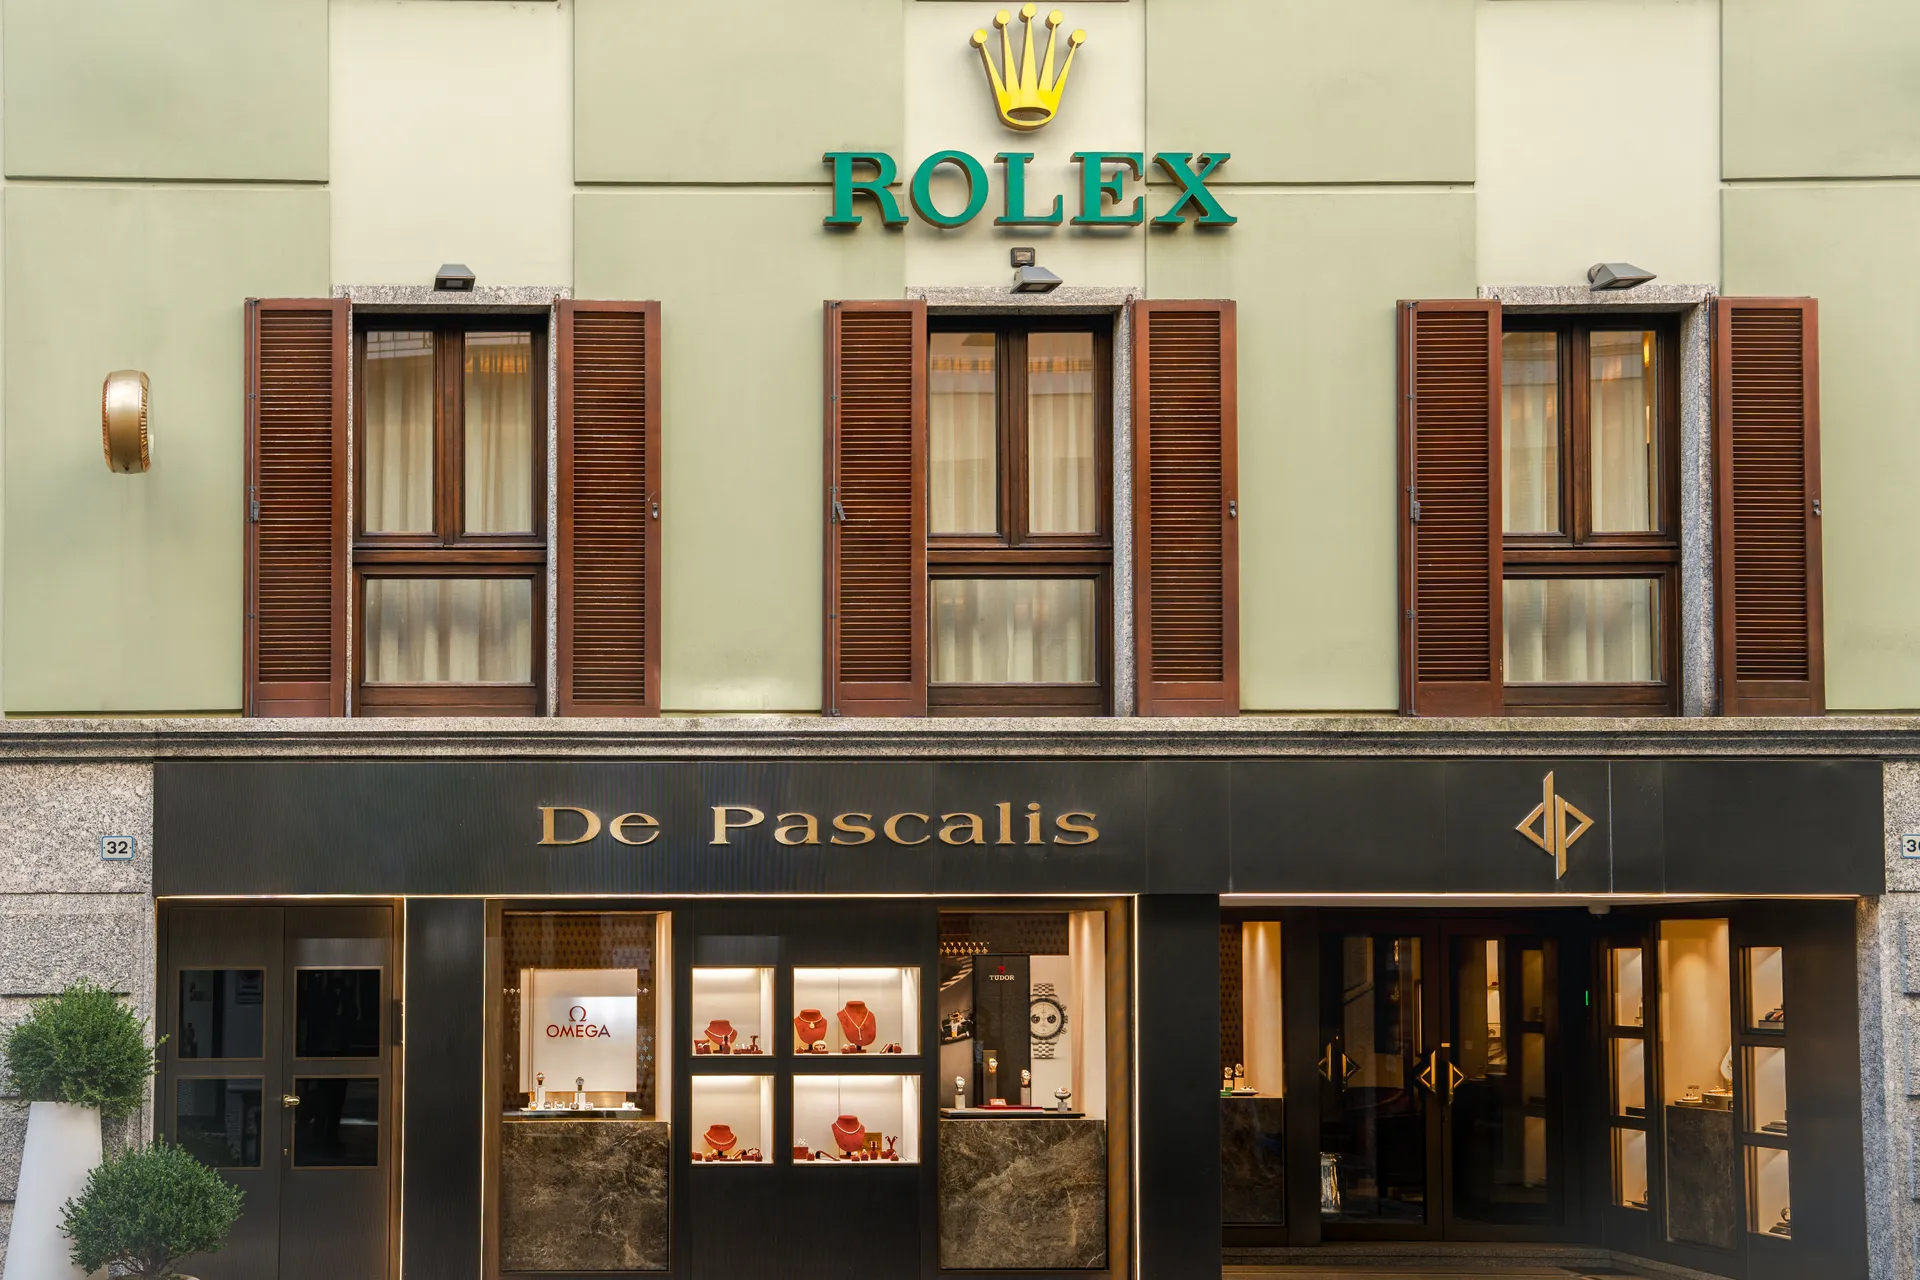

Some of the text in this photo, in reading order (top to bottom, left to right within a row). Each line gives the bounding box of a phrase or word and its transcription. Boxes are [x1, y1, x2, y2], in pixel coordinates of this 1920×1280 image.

[822, 150, 1237, 229] ROLEX
[536, 802, 1101, 846] De Pascalis
[106, 840, 128, 855] 32
[546, 1024, 611, 1038] OMEGA
